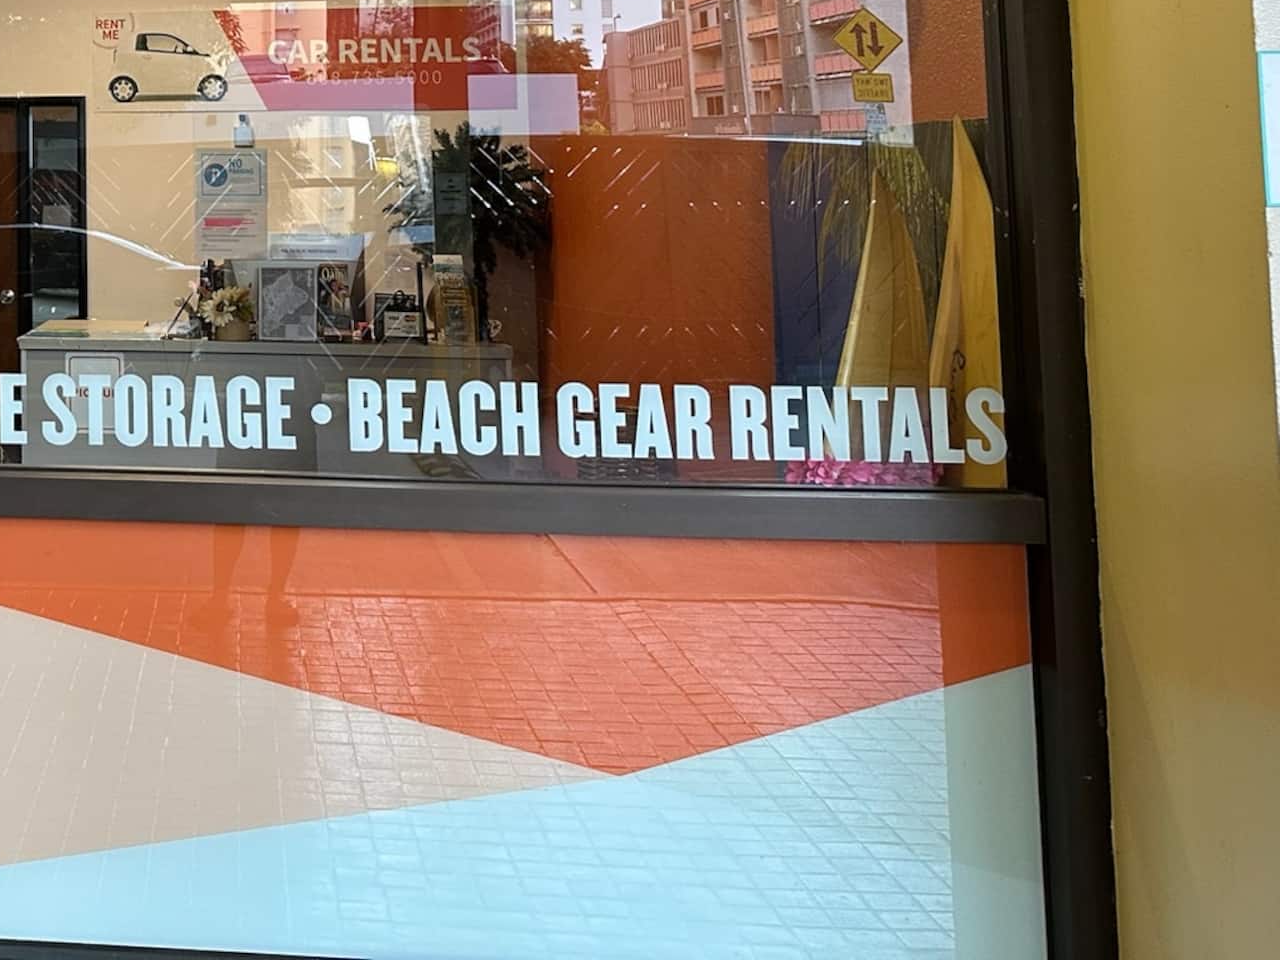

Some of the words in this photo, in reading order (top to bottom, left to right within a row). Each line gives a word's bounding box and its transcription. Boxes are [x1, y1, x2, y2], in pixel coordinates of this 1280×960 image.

[95, 18, 126, 30] RENT
[102, 30, 119, 41] ME
[268, 39, 330, 65] CAR
[338, 37, 481, 65] RENTALS
[41, 373, 297, 451] STORAGE
[347, 378, 541, 457] BEACH
[556, 381, 714, 460] GEAR
[729, 385, 1008, 465] RENTALS
